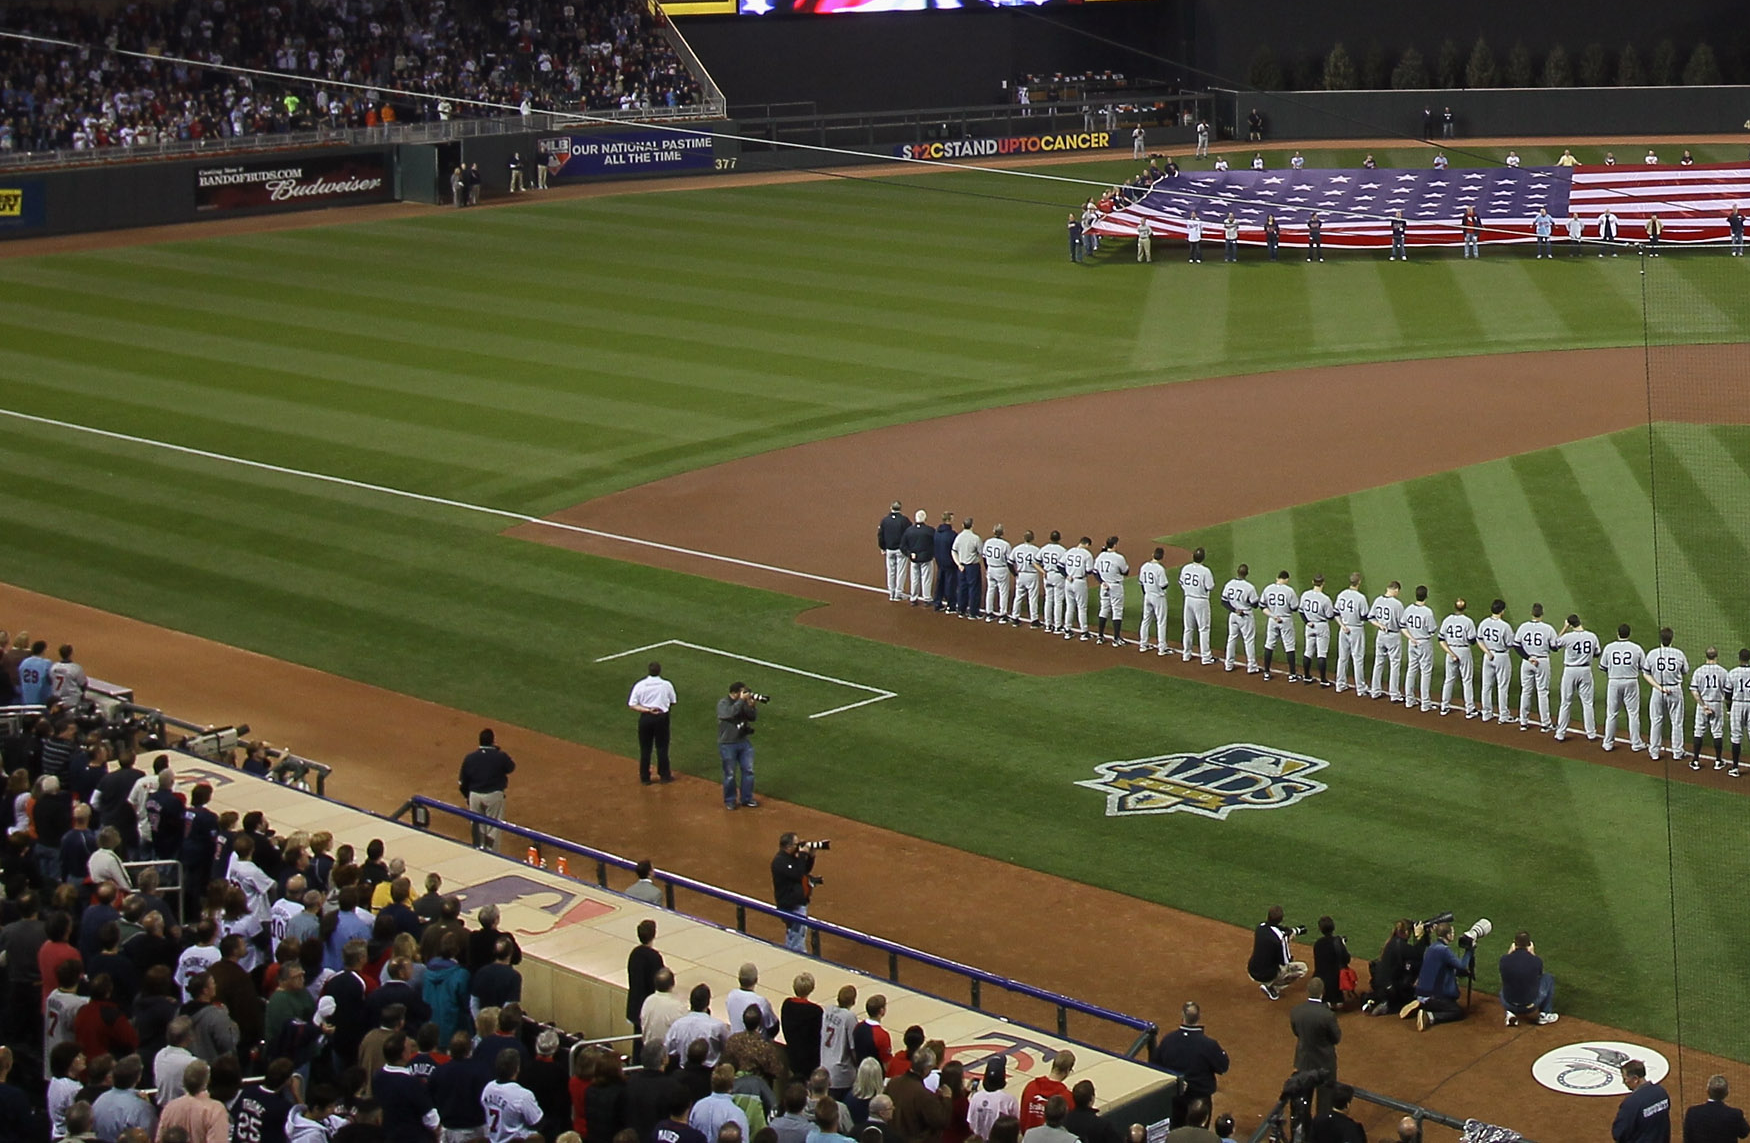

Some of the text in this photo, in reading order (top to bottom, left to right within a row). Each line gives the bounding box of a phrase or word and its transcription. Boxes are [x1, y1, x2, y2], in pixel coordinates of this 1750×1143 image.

[540, 139, 569, 152] MLB
[572, 137, 713, 156] OUR NATIONAL PASTIME
[604, 150, 682, 166] ALL THE TIME
[714, 158, 737, 170] 377
[200, 168, 302, 187] BANDOFBUDS.COM
[266, 175, 381, 201] Budweiser
[986, 546, 1001, 559] 50
[1016, 552, 1032, 565] 54
[1043, 552, 1058, 565] 56
[1067, 555, 1082, 567] 59
[1100, 560, 1111, 573] 17
[1143, 571, 1155, 585] 19
[1184, 573, 1199, 587] 26
[1228, 588, 1243, 602] 27
[1268, 593, 1285, 606] 29
[1304, 599, 1319, 614] 30
[1339, 598, 1354, 613] 34
[1376, 606, 1390, 620] 39
[1407, 615, 1422, 629] 40
[1446, 625, 1463, 639] 42
[1483, 627, 1499, 643] 45
[1523, 632, 1542, 646] 46
[1573, 640, 1592, 654] 48
[1612, 651, 1632, 665] 62
[1656, 657, 1677, 671] 65
[23, 669, 39, 684] 29
[55, 675, 65, 691] 7
[1705, 674, 1717, 688] 11
[271, 918, 285, 940] 10
[48, 1010, 59, 1038] 7
[825, 1027, 836, 1048] 7
[238, 1112, 262, 1143] 25
[489, 1108, 499, 1133] 7
[658, 1128, 680, 1143] MAUER
